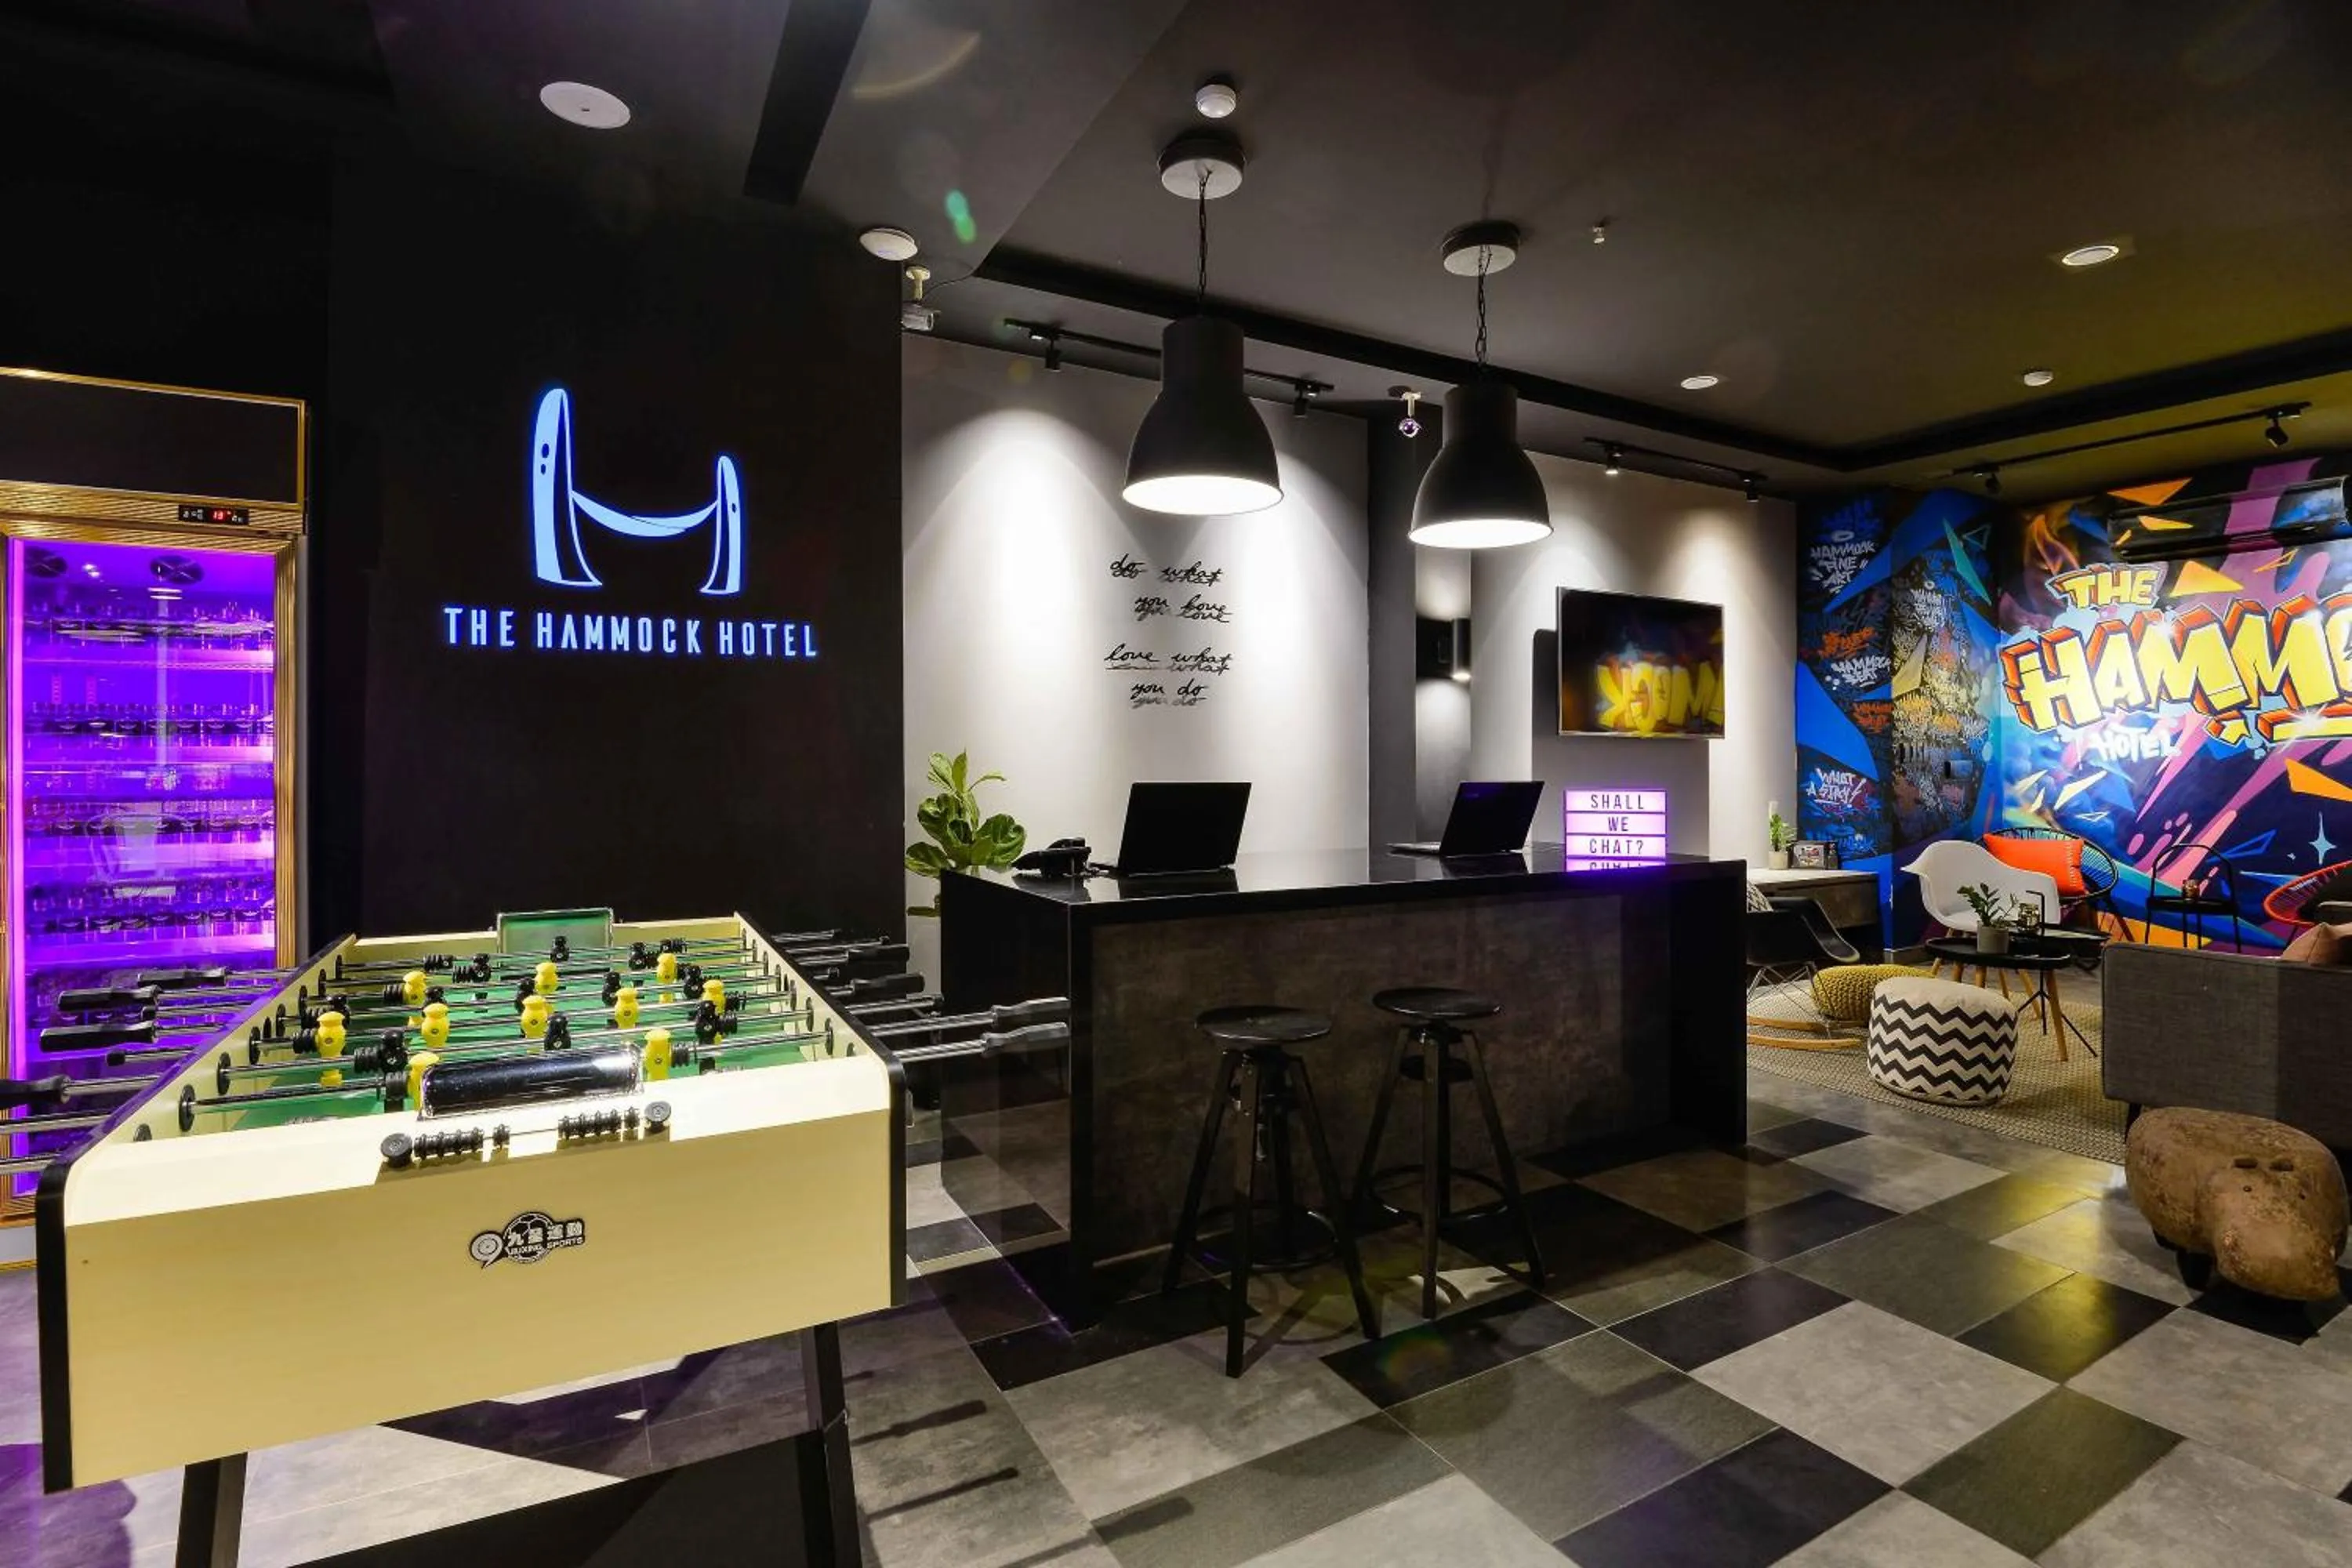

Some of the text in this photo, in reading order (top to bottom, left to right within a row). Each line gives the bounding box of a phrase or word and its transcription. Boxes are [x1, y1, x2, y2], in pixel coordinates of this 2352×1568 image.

[1110, 554, 1223, 580] do what
[2054, 564, 2161, 610] THE
[1134, 594, 1233, 615] you love
[444, 608, 817, 657] THE HAMMOCK HOTEL
[1104, 643, 1233, 666] love what
[1130, 677, 1210, 700] you do
[2092, 721, 2183, 763] HOTEL
[1590, 793, 1645, 810] SHALL
[1608, 816, 1630, 832] WE
[1589, 837, 1645, 855] CHAT?
